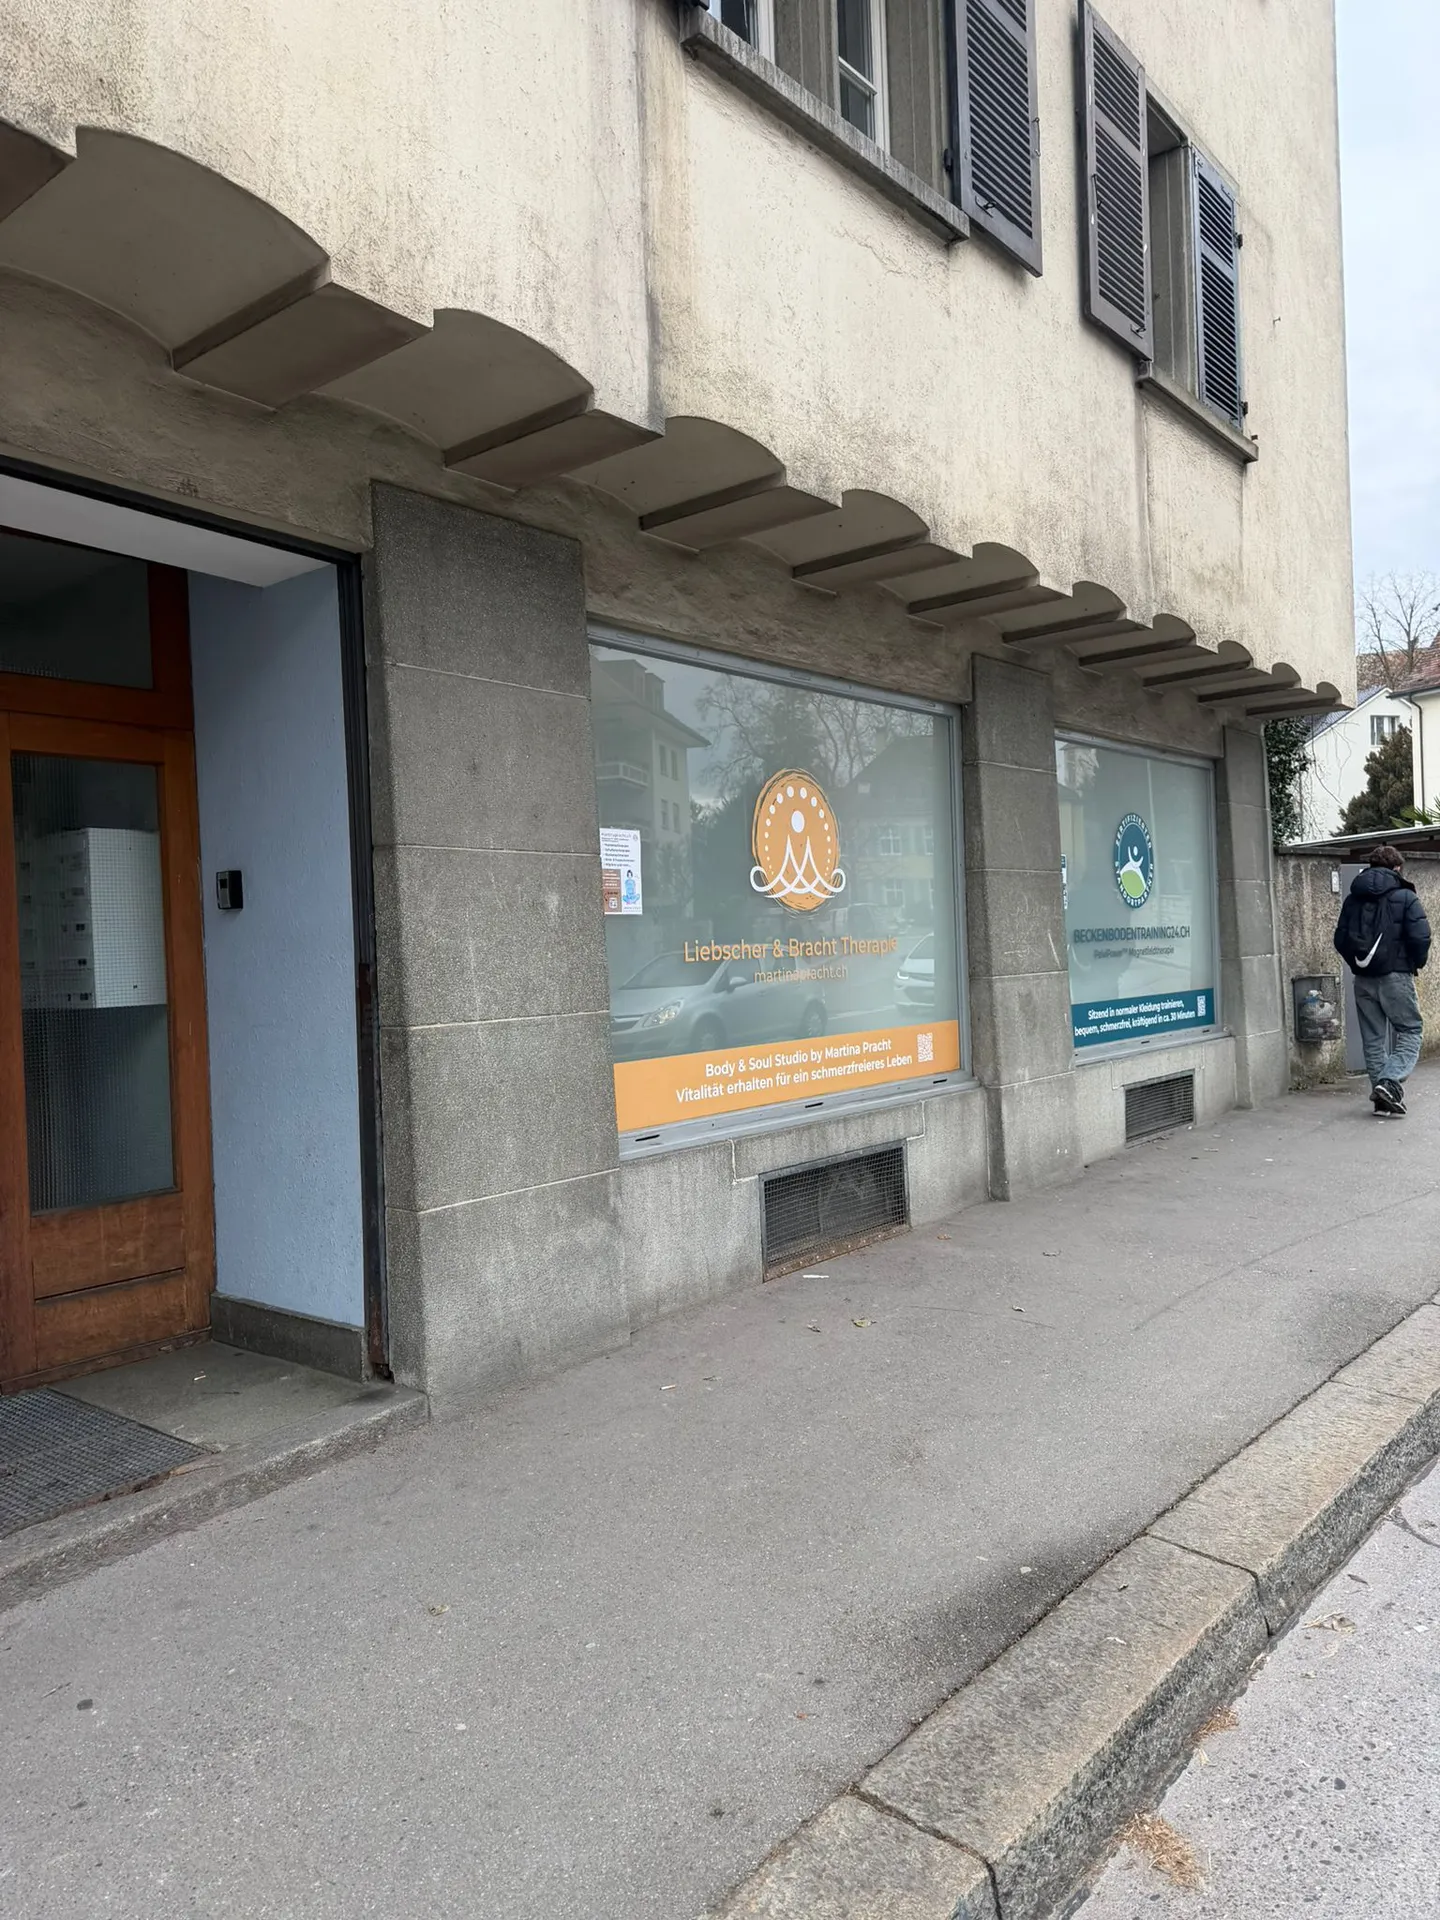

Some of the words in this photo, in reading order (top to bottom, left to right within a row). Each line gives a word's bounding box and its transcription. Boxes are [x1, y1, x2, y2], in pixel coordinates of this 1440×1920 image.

[1073, 925, 1191, 943] BECKENBODENTRAINING24.CH
[684, 939, 768, 963] Liebscher
[772, 939, 783, 959] &
[788, 937, 838, 957] Bracht
[840, 935, 898, 958] Therapie
[754, 964, 848, 984] martinapracht.ch
[1074, 1026, 1099, 1037] bequem,
[1099, 1020, 1132, 1033] schmerzfrei,
[1132, 1015, 1157, 1028] kräftigend
[1158, 1013, 1163, 1023] in
[1170, 1012, 1176, 1021] 30
[1177, 1010, 1196, 1020] Minuten
[1088, 1007, 1109, 1020] Sitzend
[1109, 1006, 1115, 1017] in
[1116, 1004, 1139, 1016] normaler
[1139, 1001, 1161, 1013] Kleidung
[706, 1059, 735, 1078] Body
[738, 1059, 746, 1073] &
[749, 1055, 772, 1071] Soul
[775, 1052, 807, 1067] Studio
[810, 1050, 823, 1063] by
[825, 1043, 860, 1060] Martina
[863, 1039, 892, 1054] Pracht
[676, 1082, 724, 1103] Vitalität
[727, 1073, 773, 1094] erhalten
[775, 1071, 792, 1087] für
[793, 1068, 809, 1083] ein
[811, 1057, 885, 1081] schmerzfreieres
[887, 1054, 912, 1068] Leben
